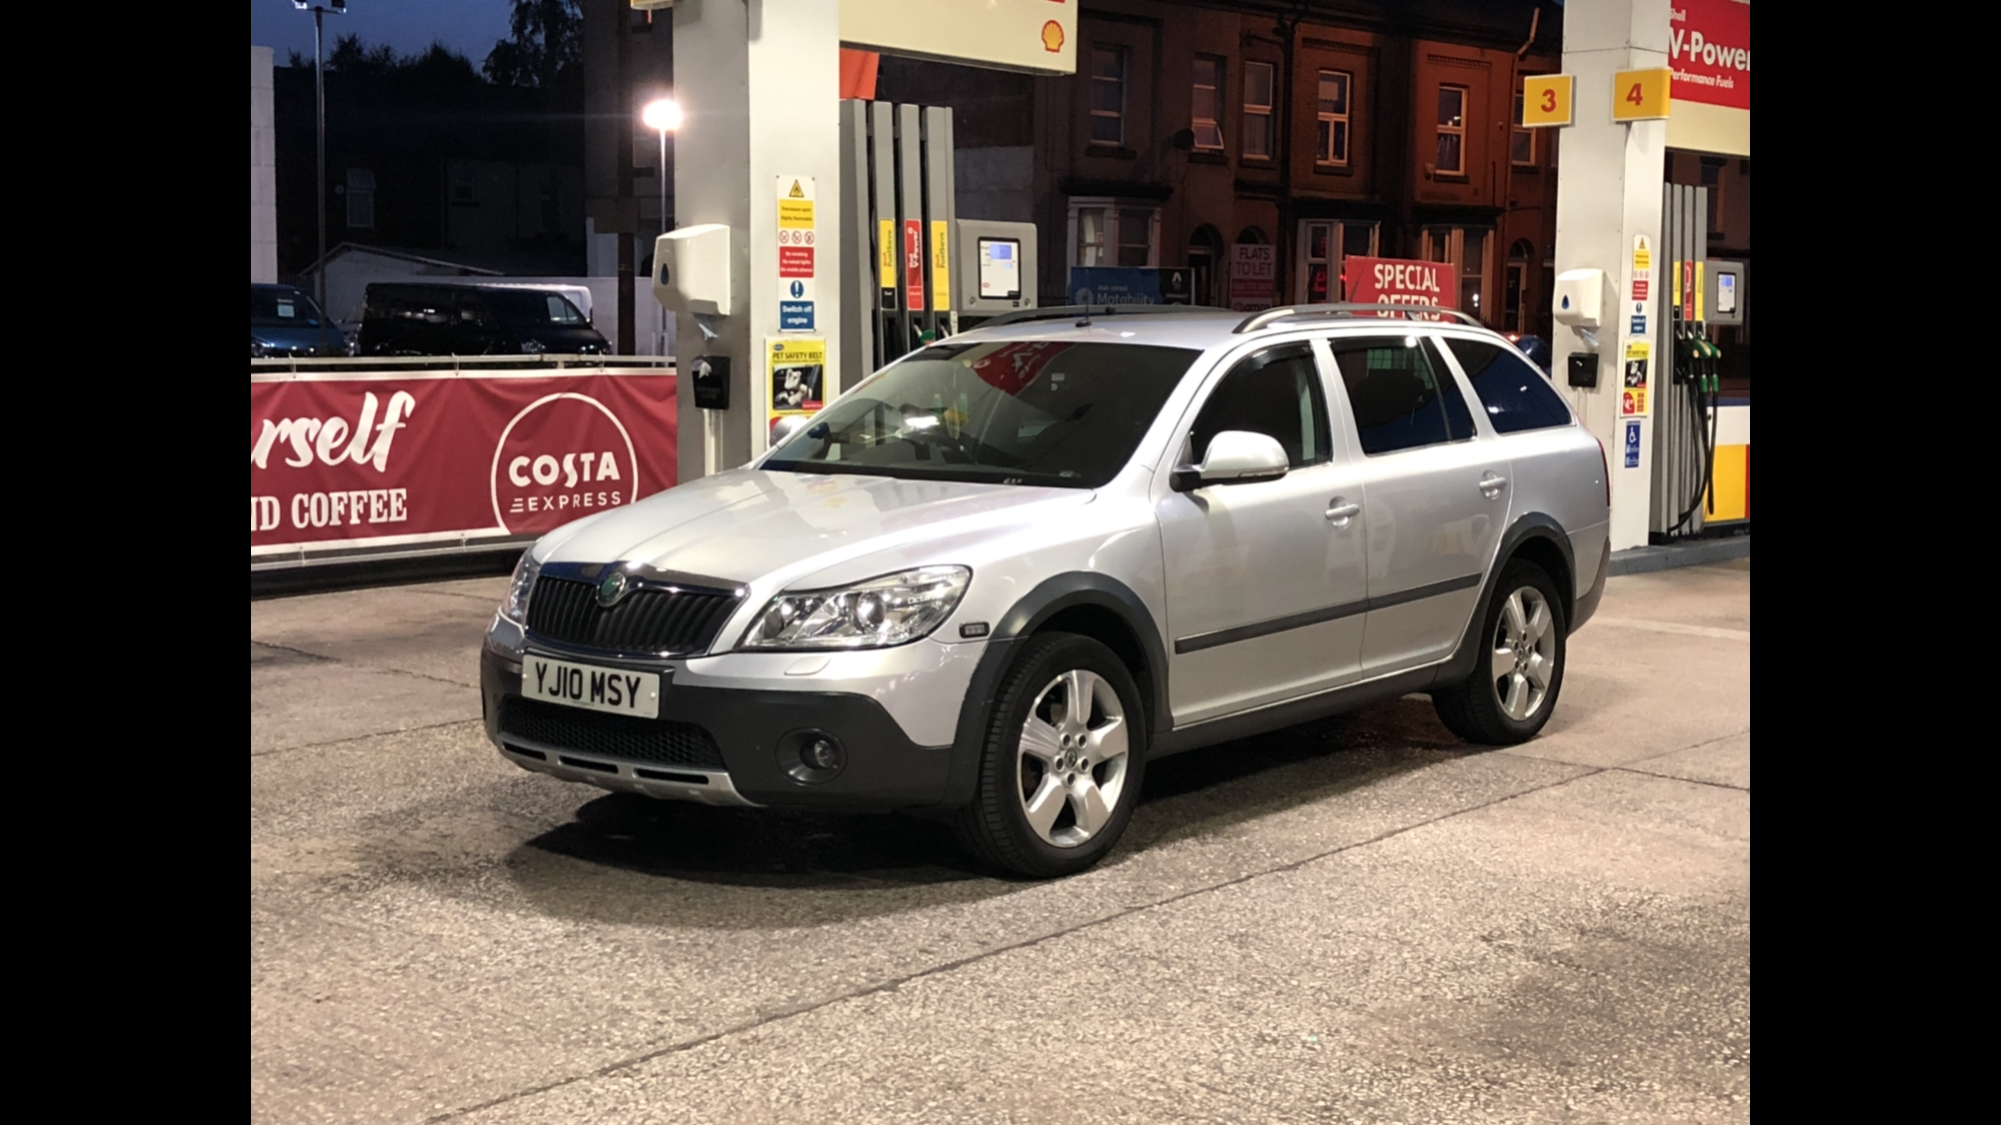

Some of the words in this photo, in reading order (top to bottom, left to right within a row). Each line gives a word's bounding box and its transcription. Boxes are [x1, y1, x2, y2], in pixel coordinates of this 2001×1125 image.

[1716, 74, 1734, 89] Fuels
[1541, 88, 1557, 113] 3
[1626, 83, 1643, 106] 4
[1240, 247, 1270, 260] FLATS
[1236, 261, 1251, 276] TO
[1252, 262, 1273, 276] LET
[1374, 263, 1440, 292] SPECIAL
[1097, 292, 1155, 305] Motability
[782, 305, 803, 313] Switch
[804, 305, 813, 313] off
[787, 316, 808, 325] engine
[772, 351, 784, 359] PET
[785, 351, 807, 359] SAFETY
[808, 351, 823, 359] BELT
[251, 390, 416, 473] rself
[509, 451, 621, 488] COSTA
[291, 488, 407, 529] COFFEE
[528, 491, 621, 511] EXPRESS
[535, 661, 583, 700] YJ10
[590, 670, 641, 708] MSY
